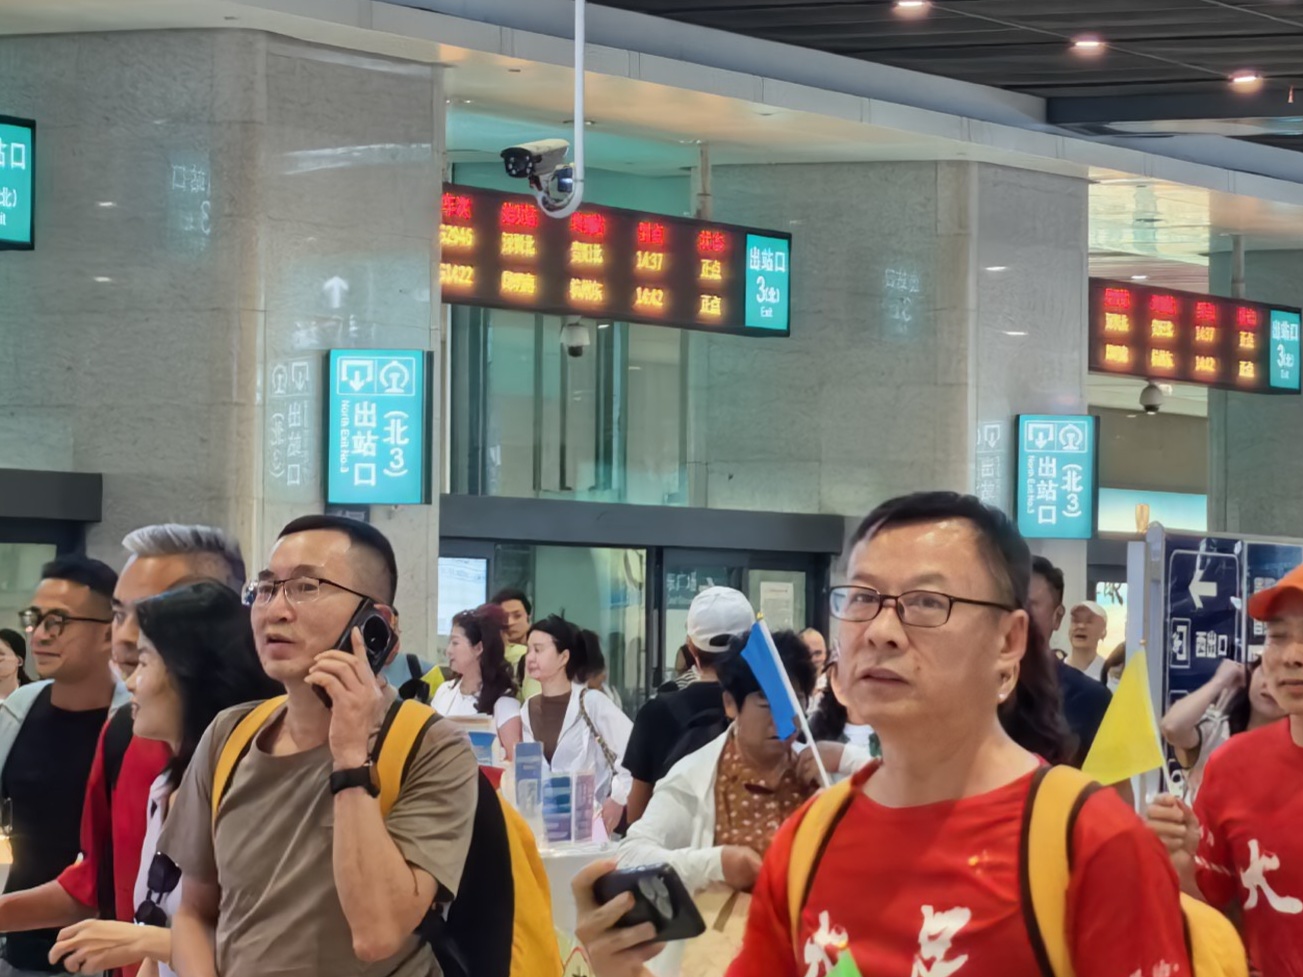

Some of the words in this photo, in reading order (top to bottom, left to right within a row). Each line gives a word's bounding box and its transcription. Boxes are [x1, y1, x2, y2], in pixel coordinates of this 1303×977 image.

[636, 250, 664, 272] 14:37
[700, 259, 722, 280] 正点
[749, 246, 786, 273] 出站口
[699, 295, 722, 316] 正点
[351, 401, 380, 487] 出站口
[1036, 456, 1059, 525] 出站口
